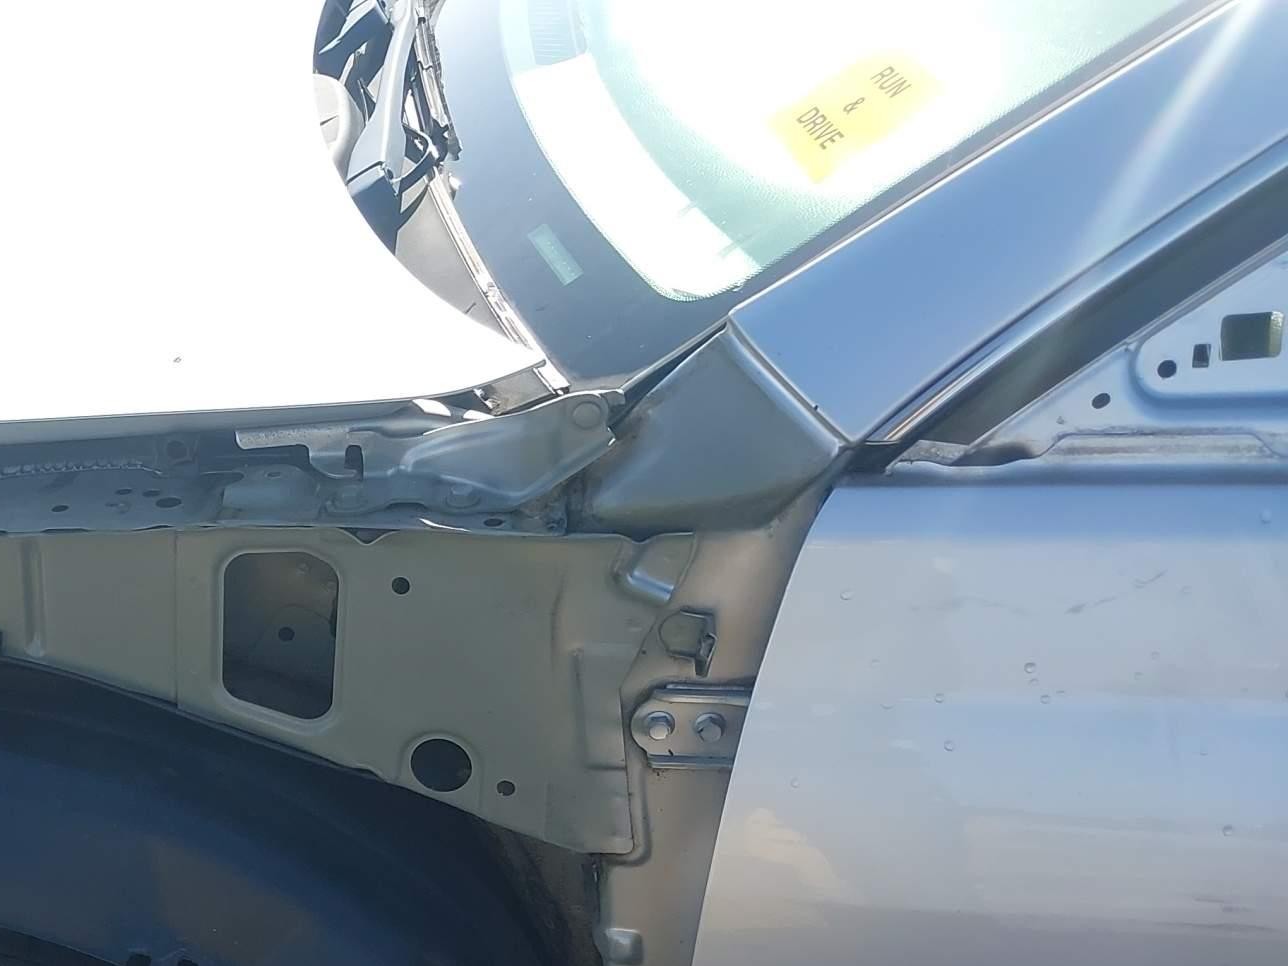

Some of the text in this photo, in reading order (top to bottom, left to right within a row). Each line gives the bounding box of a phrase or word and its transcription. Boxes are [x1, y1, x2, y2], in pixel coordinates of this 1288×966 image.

[870, 66, 912, 98] RUN
[842, 97, 866, 115] &
[796, 106, 845, 150] DRIVE
